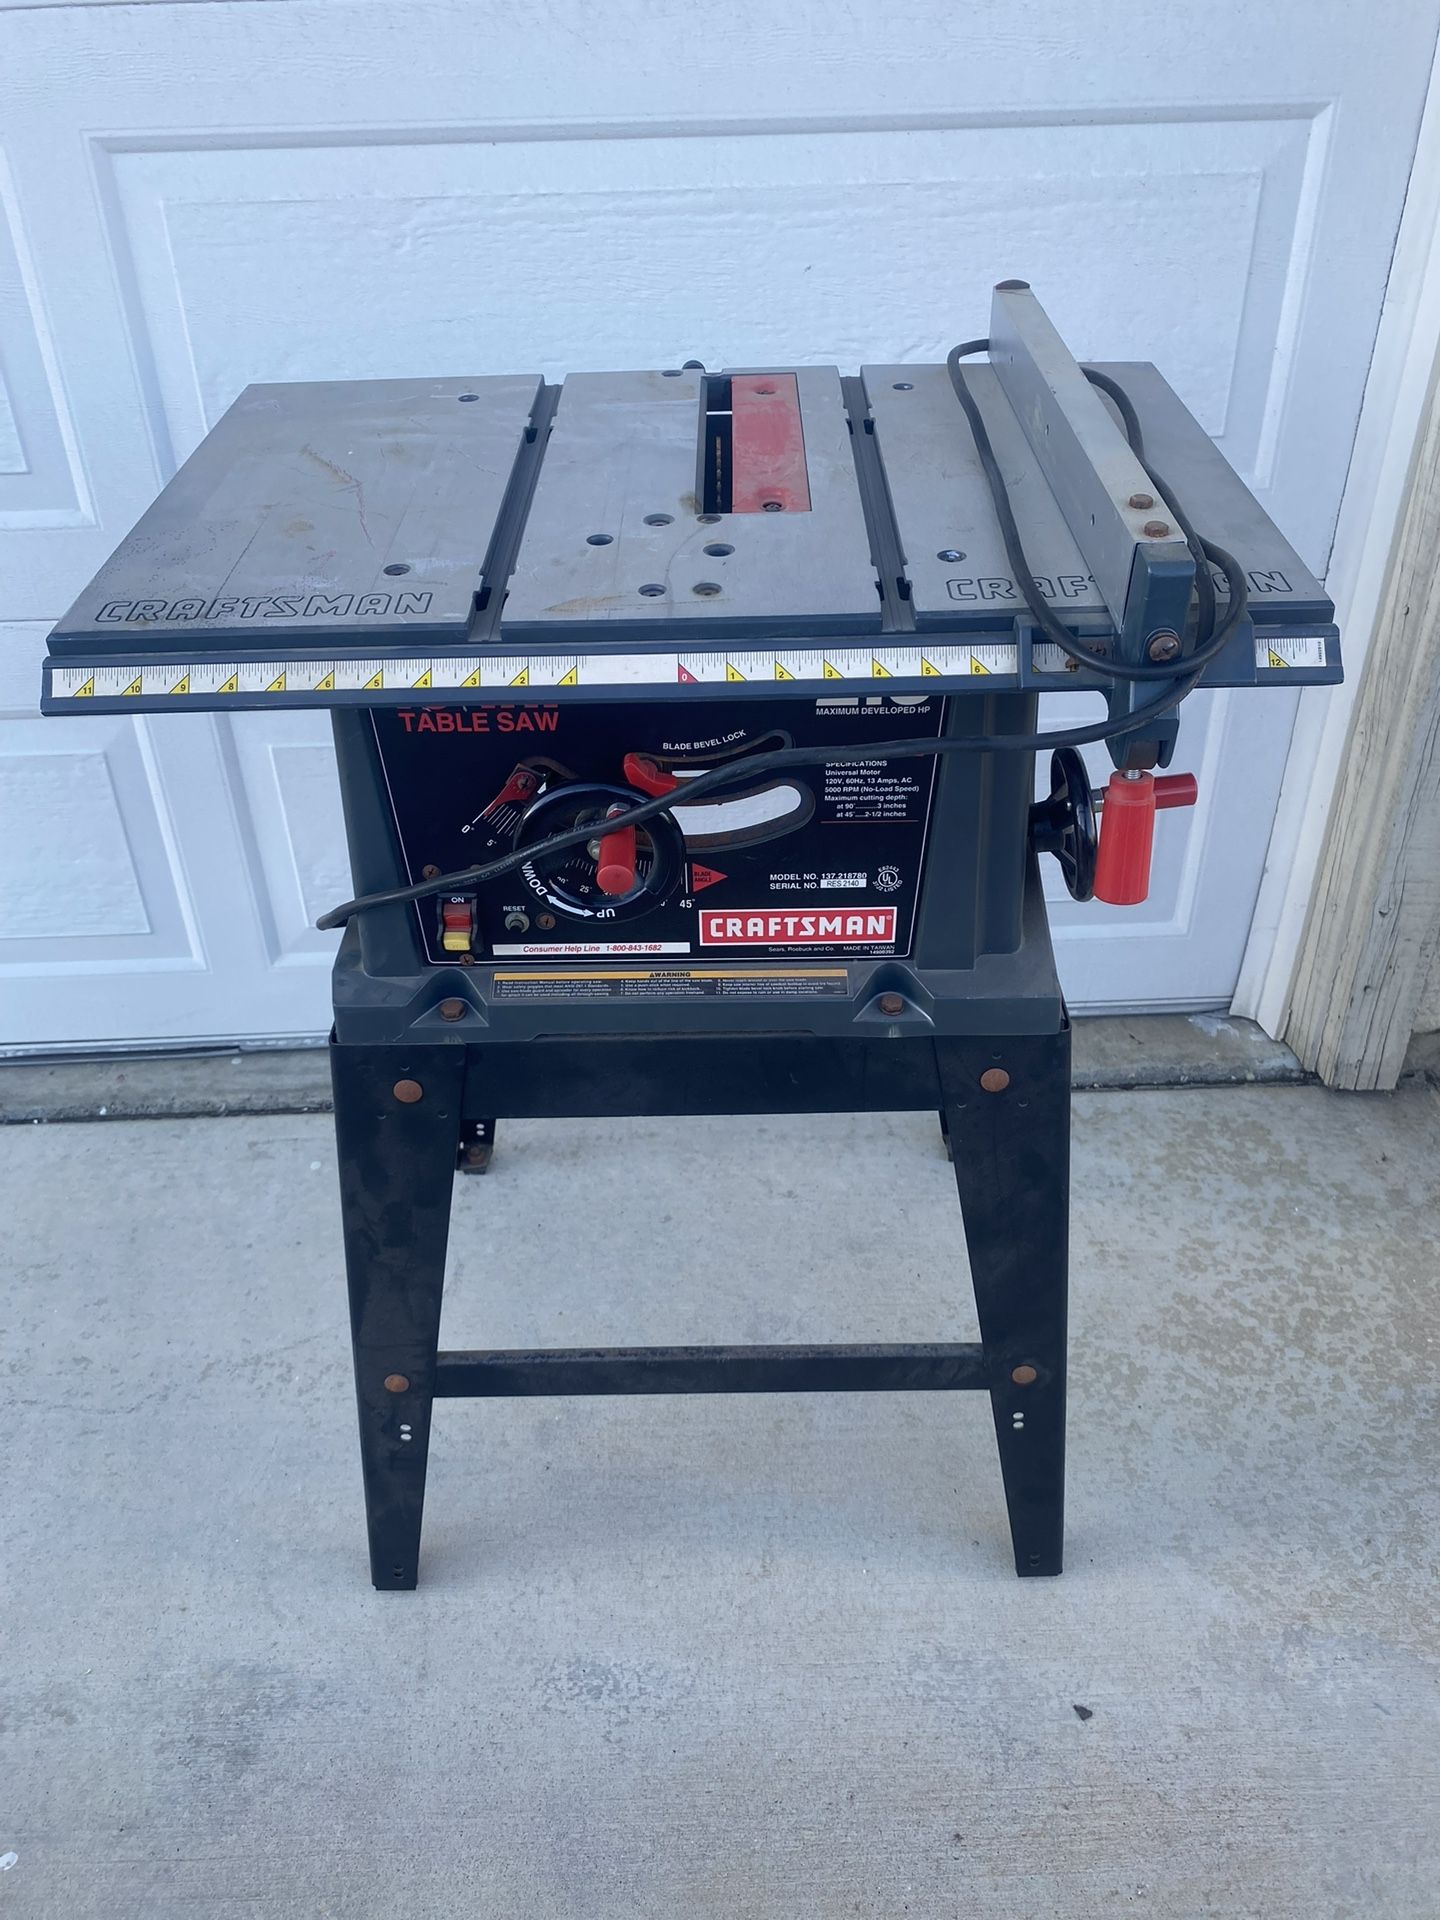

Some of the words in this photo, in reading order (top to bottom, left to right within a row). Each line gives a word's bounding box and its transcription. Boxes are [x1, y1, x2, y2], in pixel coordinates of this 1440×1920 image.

[95, 592, 433, 623] CRAFTSMAN
[82, 686, 93, 695] 11
[130, 684, 141, 693] 10
[180, 683, 186, 692] 9
[228, 681, 234, 691] 8
[276, 680, 283, 690] 7
[325, 680, 331, 688] 6
[374, 679, 380, 687] 5
[422, 679, 428, 687] 4
[471, 677, 477, 686] 3
[519, 676, 526, 685] 2
[569, 676, 574, 684] 1
[681, 673, 688, 682] 0
[731, 671, 736, 680] 1
[778, 670, 785, 679] 2
[827, 669, 834, 678] 3
[875, 668, 882, 677] 4
[925, 667, 931, 675] 5
[974, 665, 981, 674] 6
[816, 707, 859, 715] MAXIMUM
[861, 706, 916, 714] DEVELOPED
[398, 712, 490, 732] TABLE
[496, 711, 559, 732] SAW
[662, 742, 692, 750] BLADE
[693, 738, 722, 750] BEVEL
[722, 729, 747, 743] LOCK
[769, 873, 801, 881] MODEL
[769, 882, 801, 890] SERIAL
[596, 908, 616, 918] UP
[710, 915, 886, 938] CRAFTSMAN
[523, 945, 563, 953] Consumer
[564, 945, 582, 953] Help
